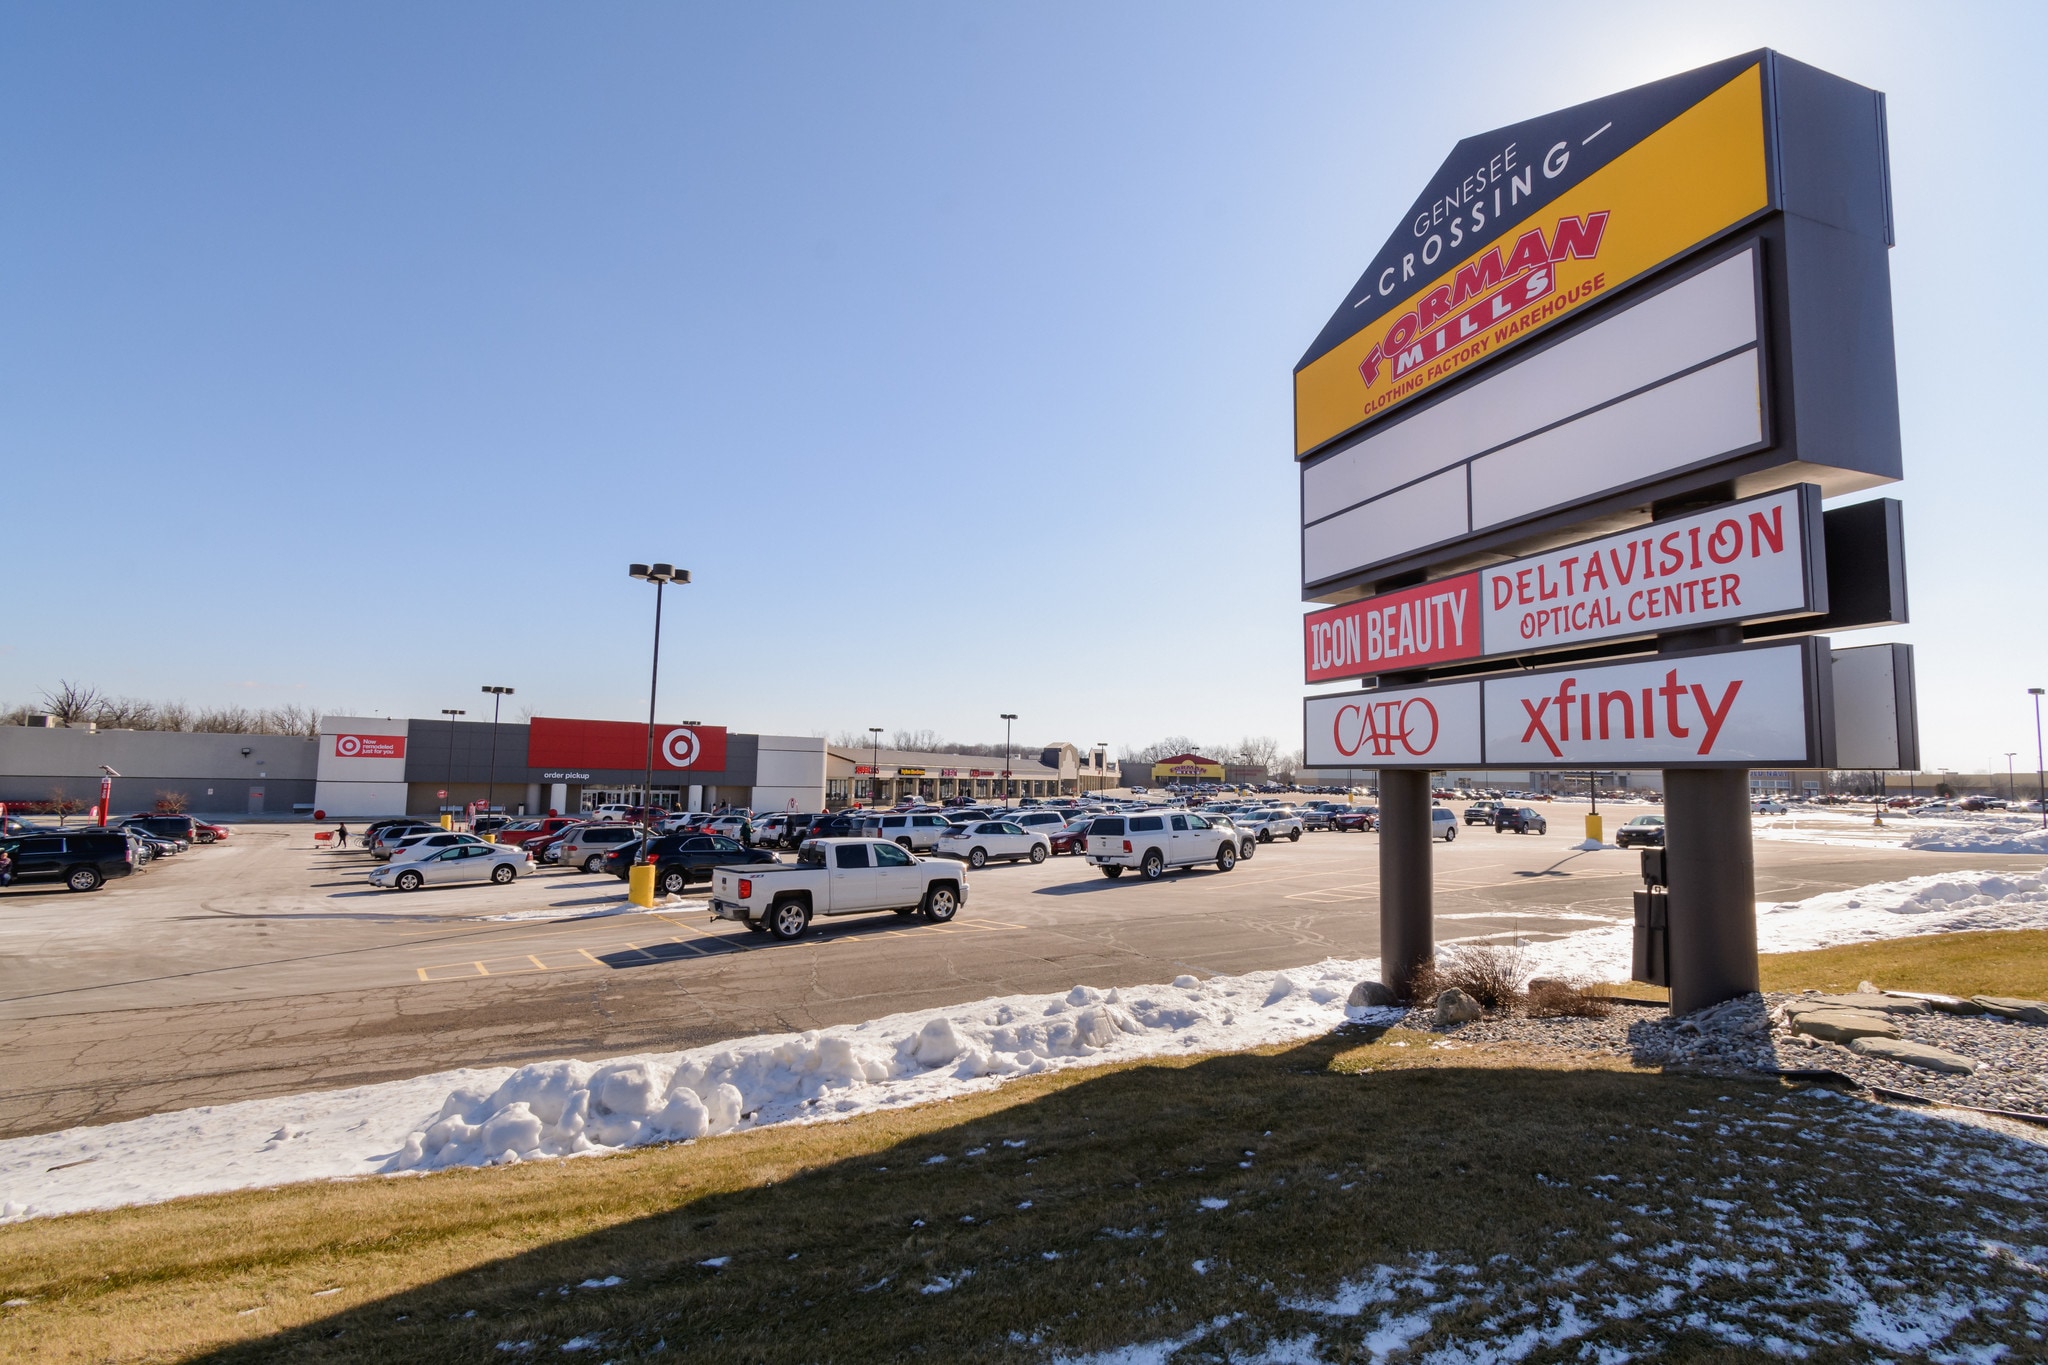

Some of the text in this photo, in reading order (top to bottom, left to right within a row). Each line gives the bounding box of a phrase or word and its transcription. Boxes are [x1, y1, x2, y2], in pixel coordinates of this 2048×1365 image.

[1378, 140, 1571, 298] CROSSING
[1412, 142, 1518, 238] GENESEE
[1360, 209, 1611, 389] FORMAN
[1363, 272, 1606, 416] CLOTHING FACTORY WAREHOUSE
[1396, 268, 1550, 375] MILLS
[1492, 505, 1785, 611] DELTAVISION
[1311, 588, 1468, 672] ICON BEAUTY
[1520, 573, 1741, 640] OPTICAL CENTER
[1333, 696, 1439, 757] CATO
[1520, 668, 1743, 757] xfinity
[565, 772, 590, 780] pickup
